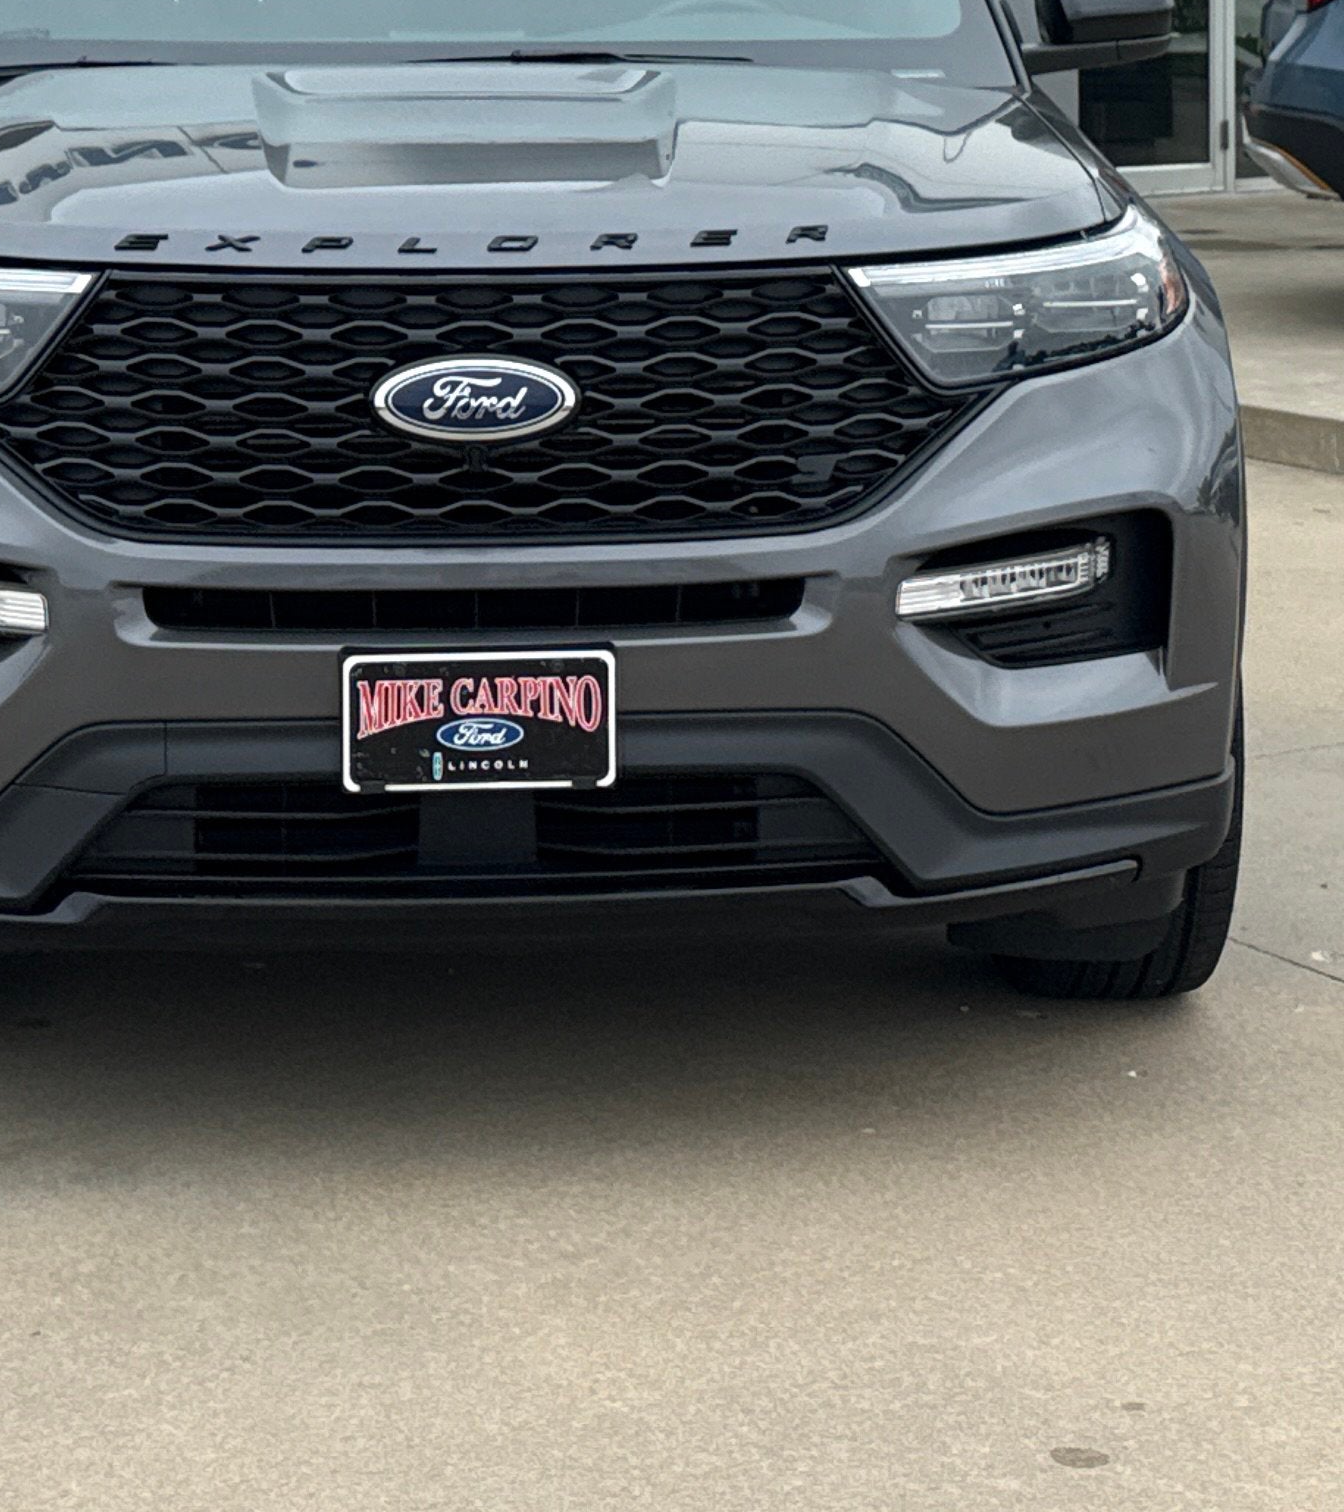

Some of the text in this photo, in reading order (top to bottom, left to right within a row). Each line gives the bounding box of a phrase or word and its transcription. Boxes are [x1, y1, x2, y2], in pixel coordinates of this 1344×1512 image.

[113, 224, 830, 255] EXPLORER
[422, 375, 529, 420] Ford
[357, 674, 602, 739] MIKE CARPINO
[453, 722, 508, 745] Ford
[447, 759, 529, 771] LINCOLN
